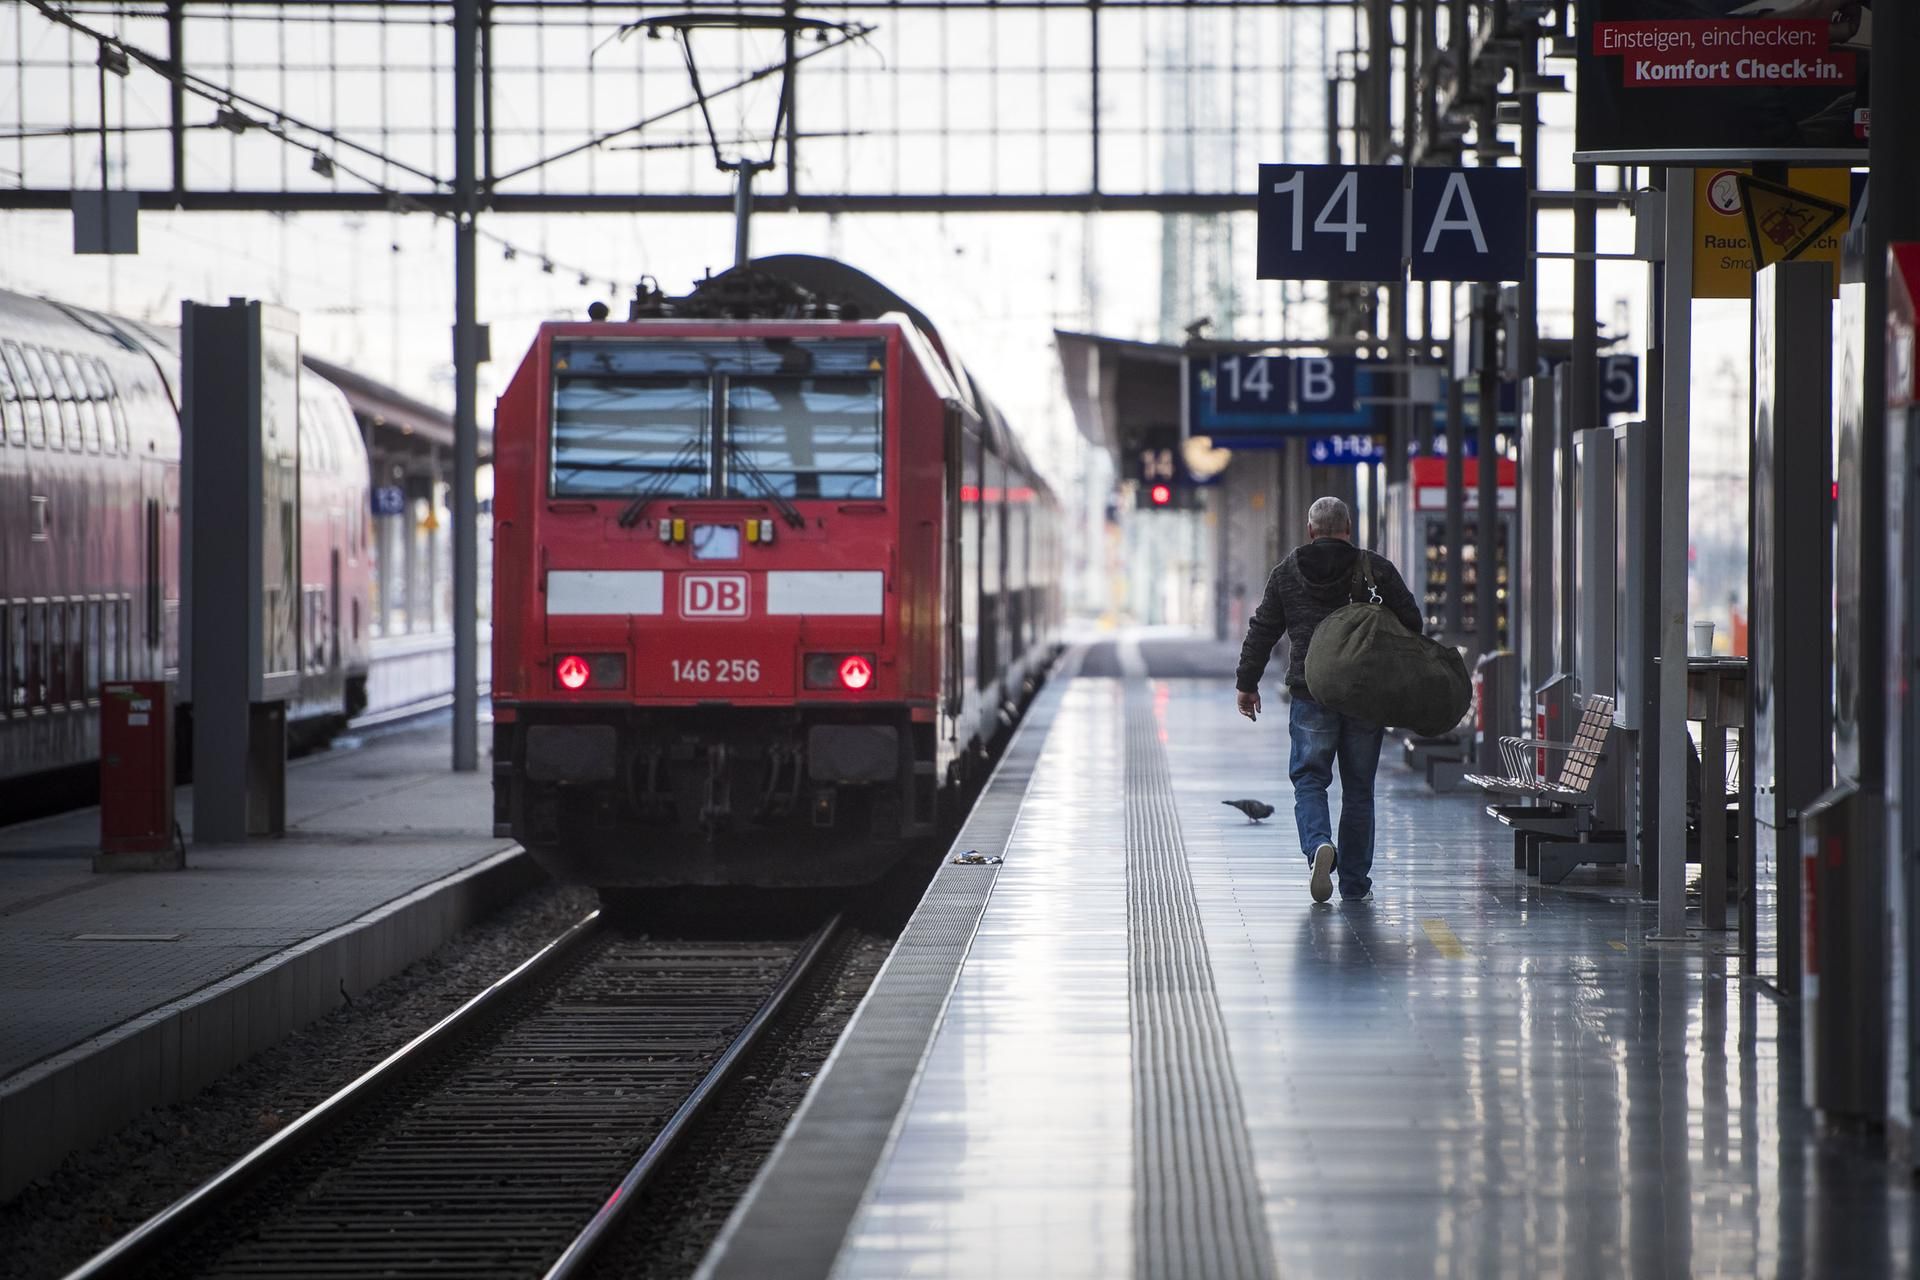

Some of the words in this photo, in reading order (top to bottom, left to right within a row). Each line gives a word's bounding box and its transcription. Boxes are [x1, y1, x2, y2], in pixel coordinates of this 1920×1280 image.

[1603, 27, 1696, 51] Einsteigen,
[1702, 25, 1816, 47] einchecken:
[1636, 59, 1730, 80] Komfort
[1735, 57, 1843, 79] Check-in.
[1274, 170, 1368, 252] 14
[1422, 172, 1489, 253] A
[1220, 356, 1274, 401] 14
[1302, 357, 1336, 401] B
[689, 580, 741, 611] DB
[671, 659, 711, 682] 146
[716, 659, 761, 682] 256
